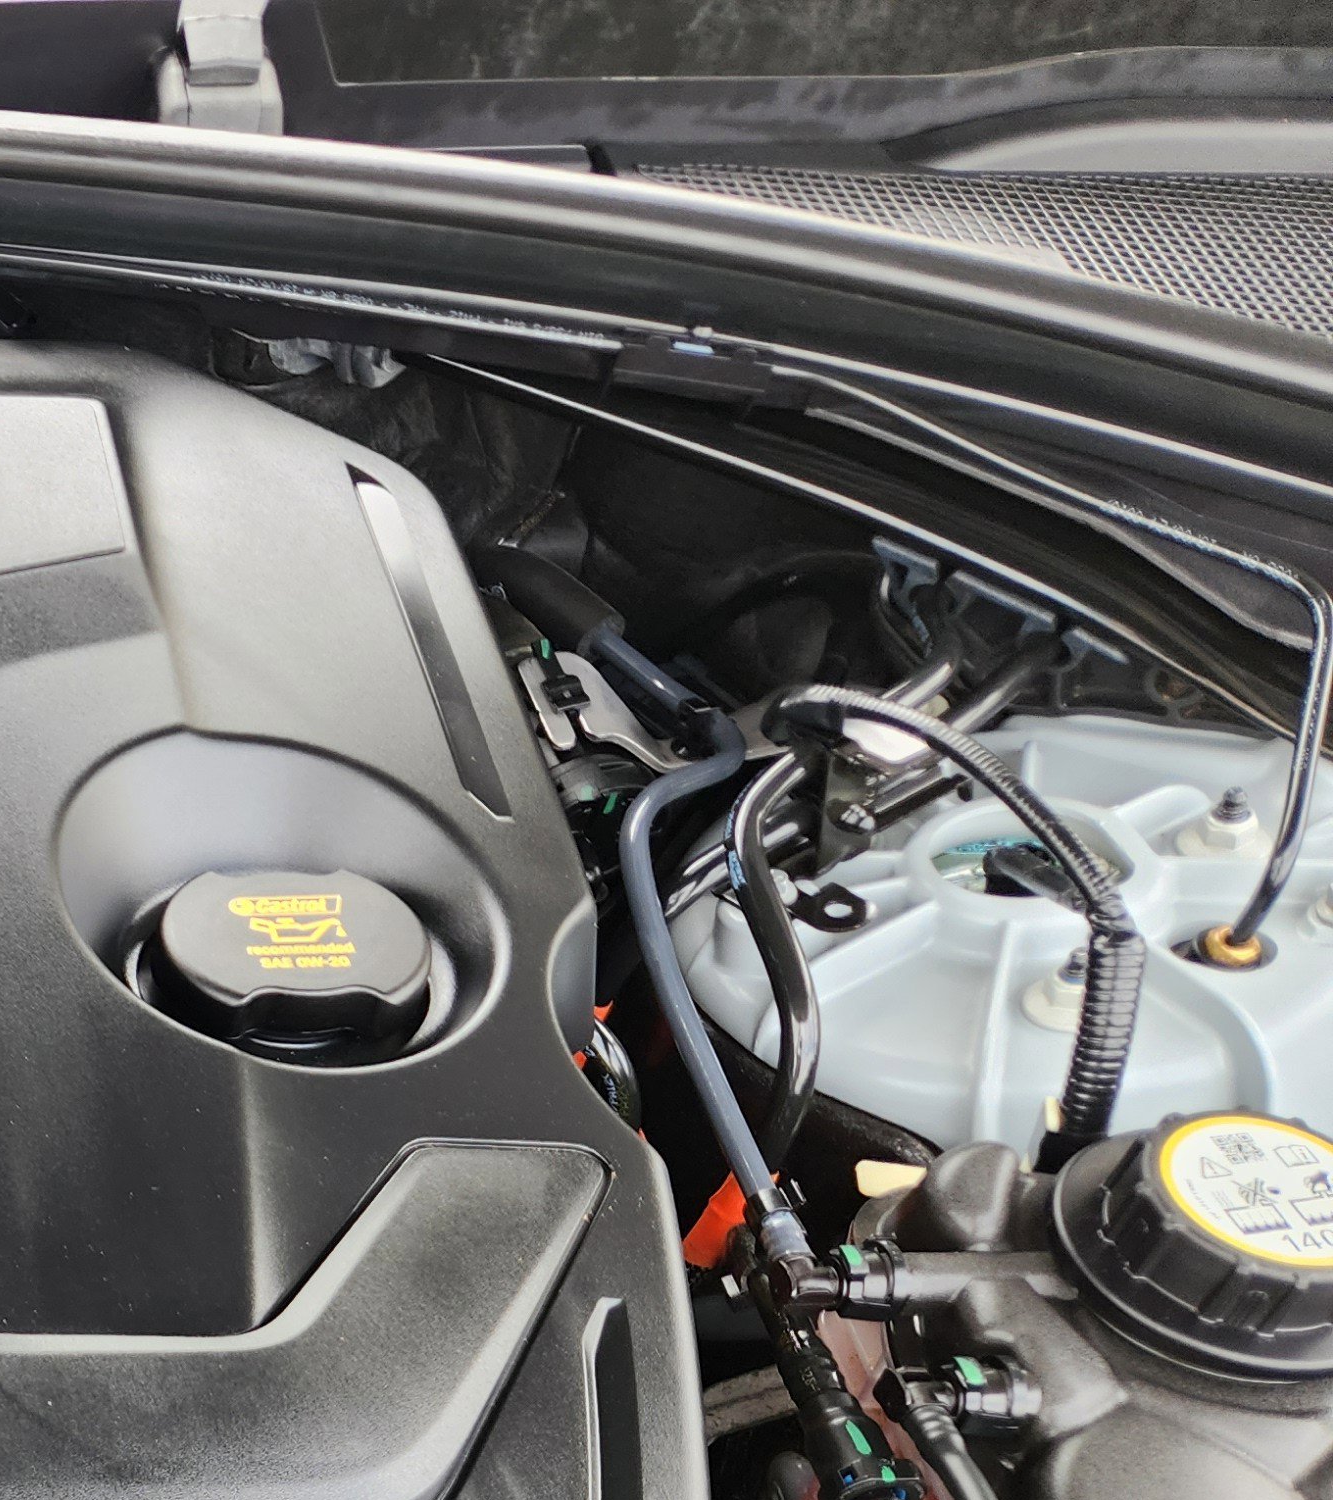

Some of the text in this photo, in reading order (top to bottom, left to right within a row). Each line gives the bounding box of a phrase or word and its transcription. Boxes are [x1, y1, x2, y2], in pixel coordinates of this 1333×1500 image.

[255, 898, 327, 914] Castrol
[246, 942, 356, 955] recommended
[259, 956, 293, 969] SAE
